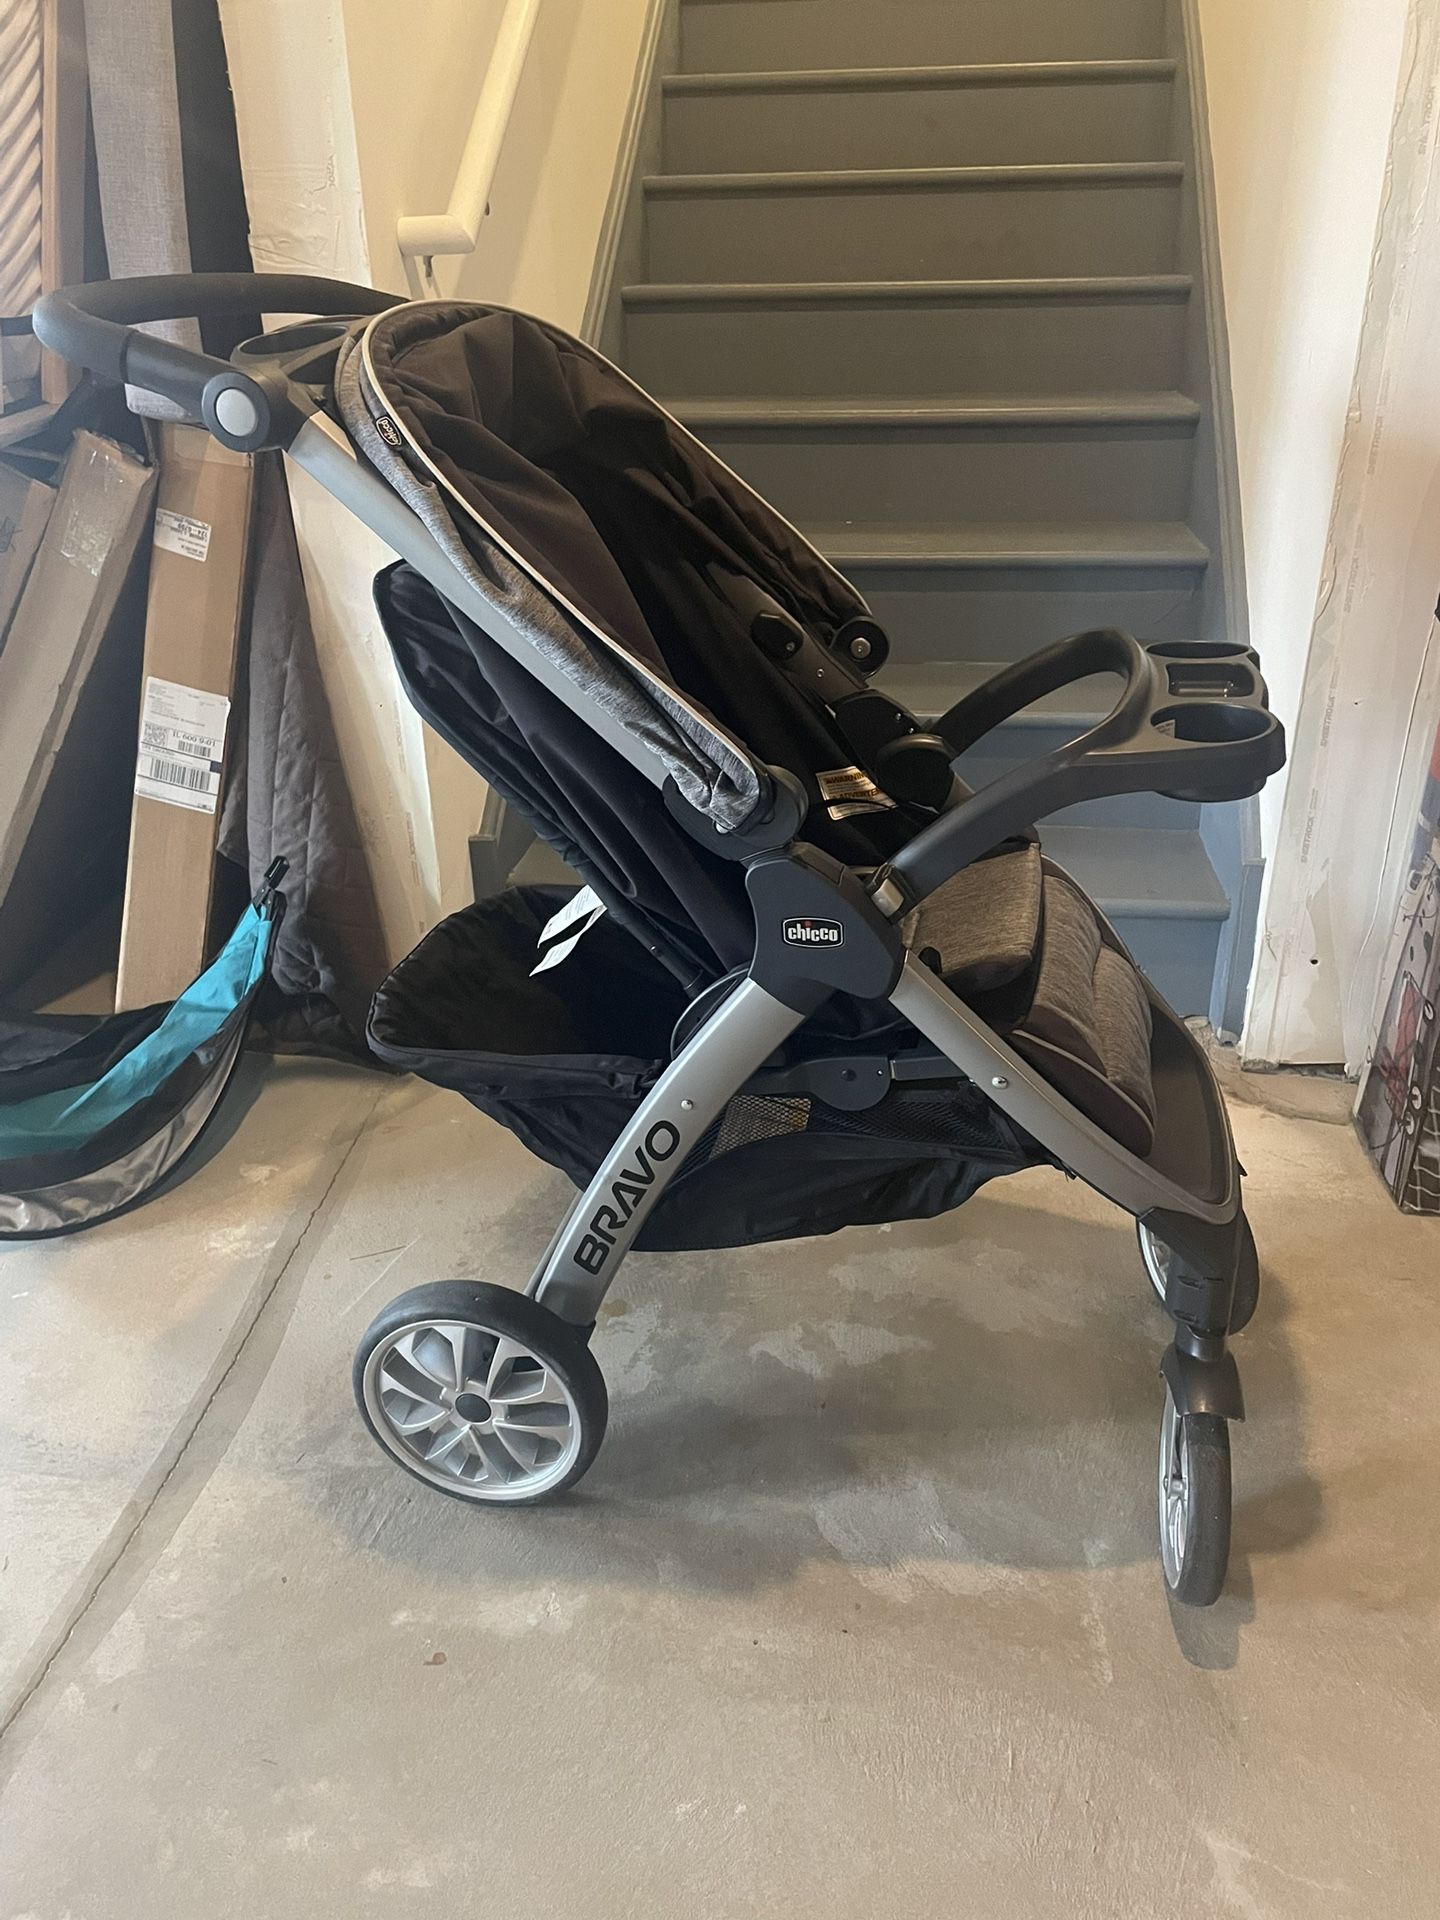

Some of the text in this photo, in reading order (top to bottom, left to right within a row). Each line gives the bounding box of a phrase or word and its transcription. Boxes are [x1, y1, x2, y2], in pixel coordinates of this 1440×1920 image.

[378, 419, 399, 443] chicco
[787, 920, 838, 942] chicco
[573, 1120, 681, 1276] BRAVO
